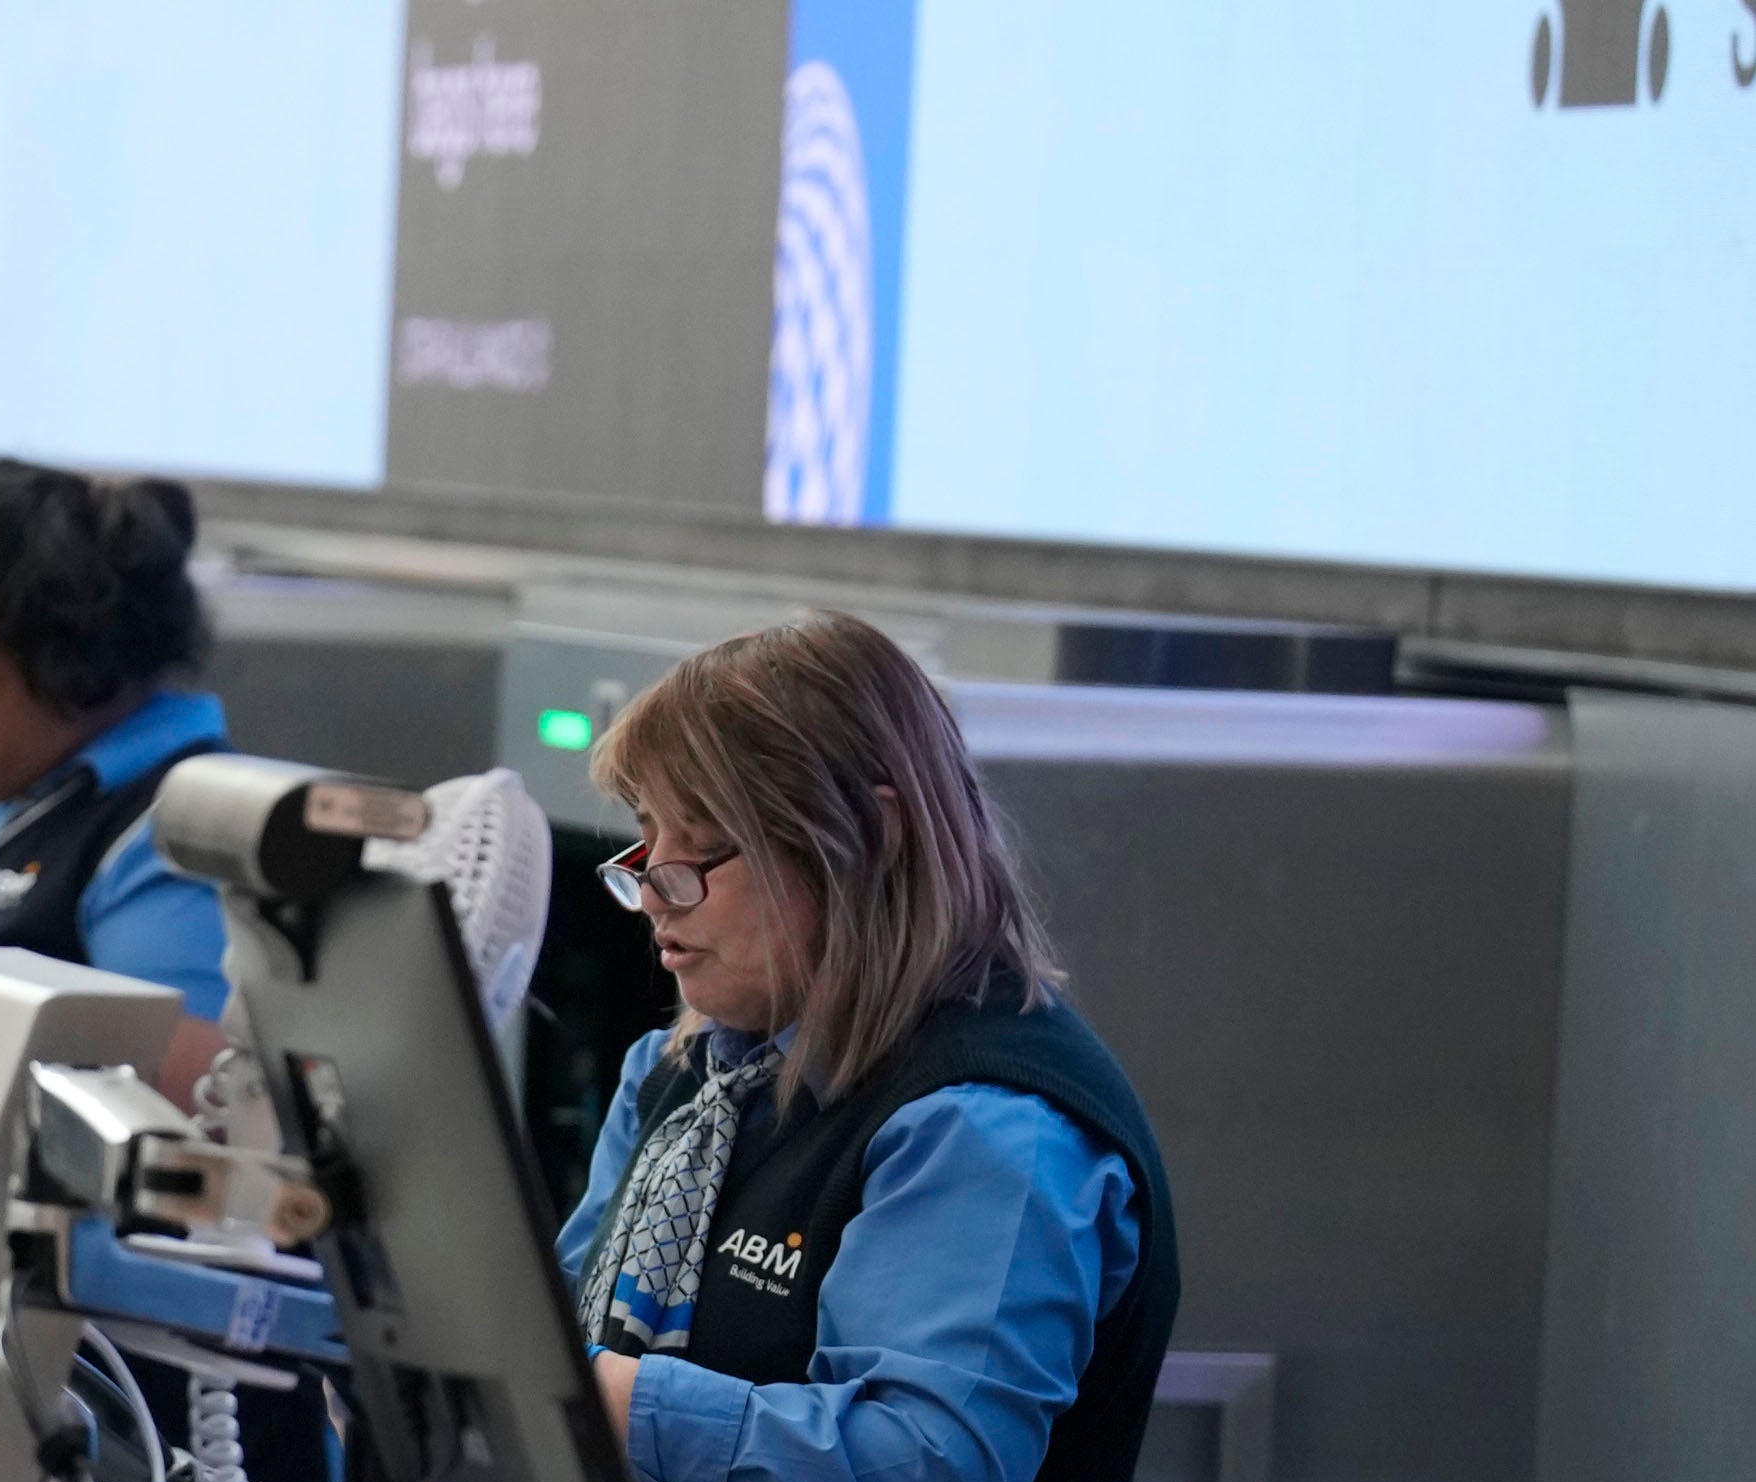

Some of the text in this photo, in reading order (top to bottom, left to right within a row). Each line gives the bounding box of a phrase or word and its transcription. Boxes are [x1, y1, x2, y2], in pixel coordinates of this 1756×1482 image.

[717, 1228, 802, 1280] ABM
[729, 1263, 790, 1297] Building Value
